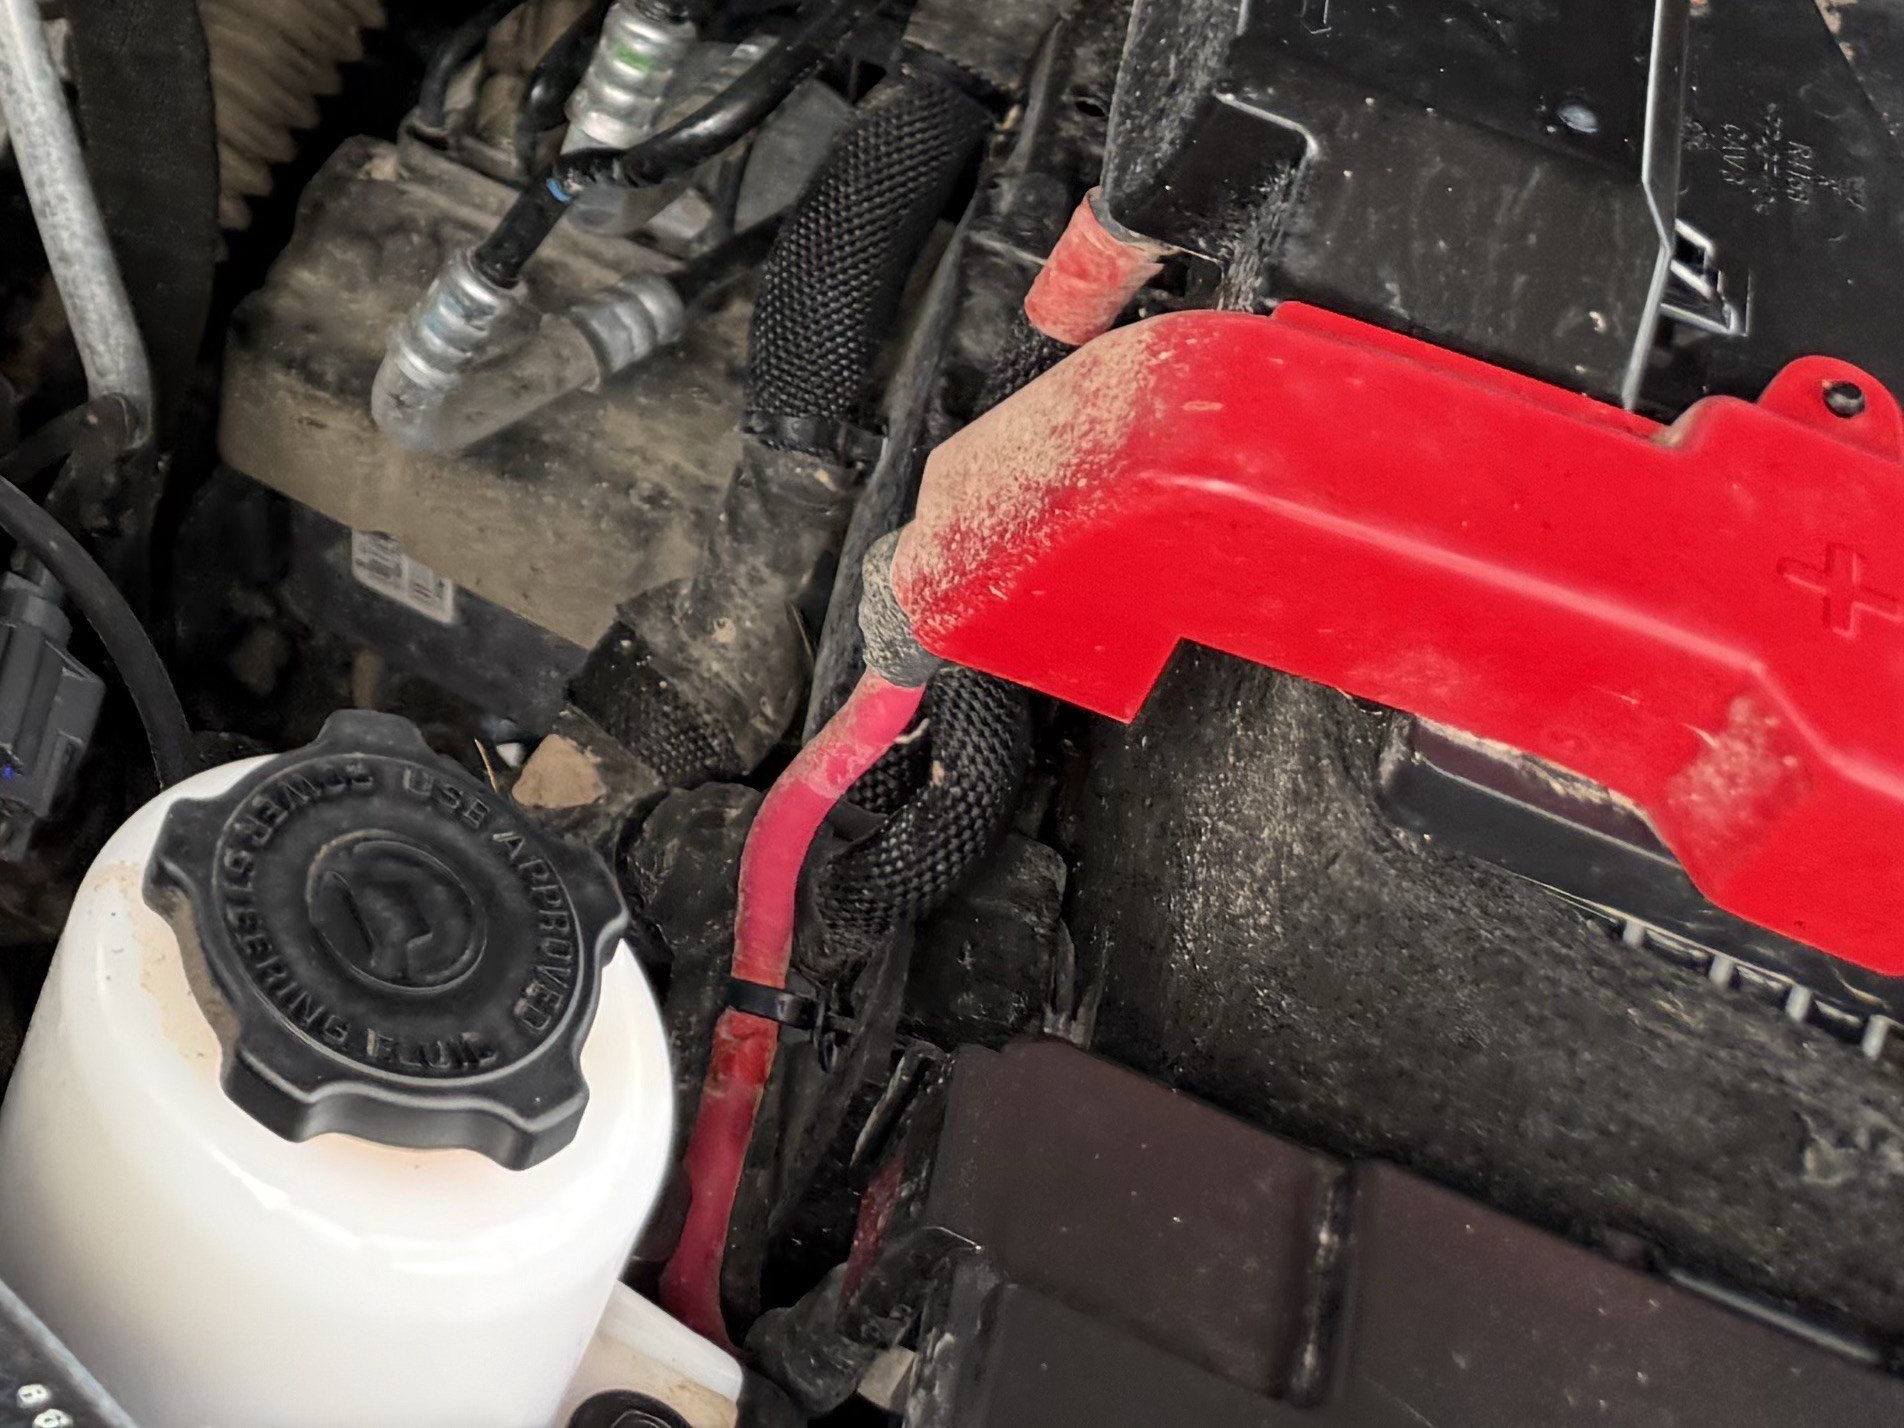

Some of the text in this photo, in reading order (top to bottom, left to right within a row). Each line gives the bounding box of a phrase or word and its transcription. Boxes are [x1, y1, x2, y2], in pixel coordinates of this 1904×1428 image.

[402, 767, 491, 830] USE
[221, 848, 353, 1046] STEERING
[492, 830, 574, 1036] APPROVED
